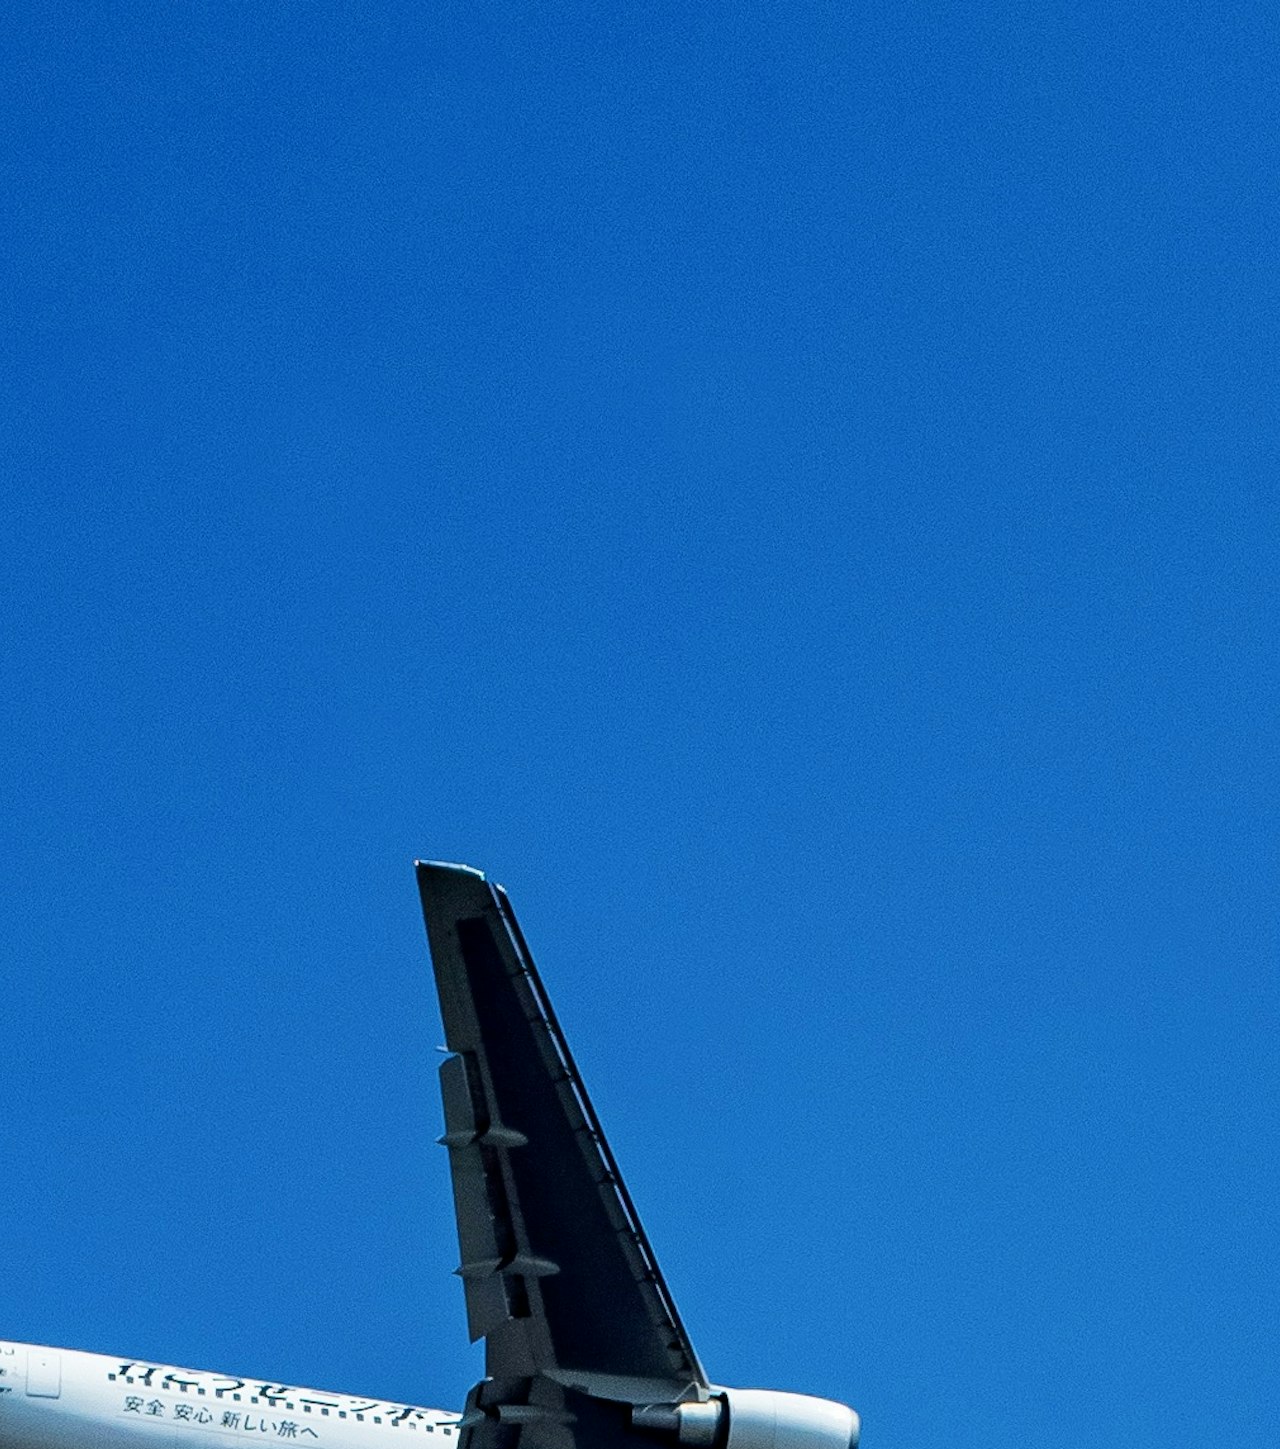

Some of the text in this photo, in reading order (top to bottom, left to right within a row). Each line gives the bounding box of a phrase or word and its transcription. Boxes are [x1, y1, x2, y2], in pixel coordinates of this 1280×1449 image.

[123, 1396, 318, 1439] 安全 安心 新しい旅へ
